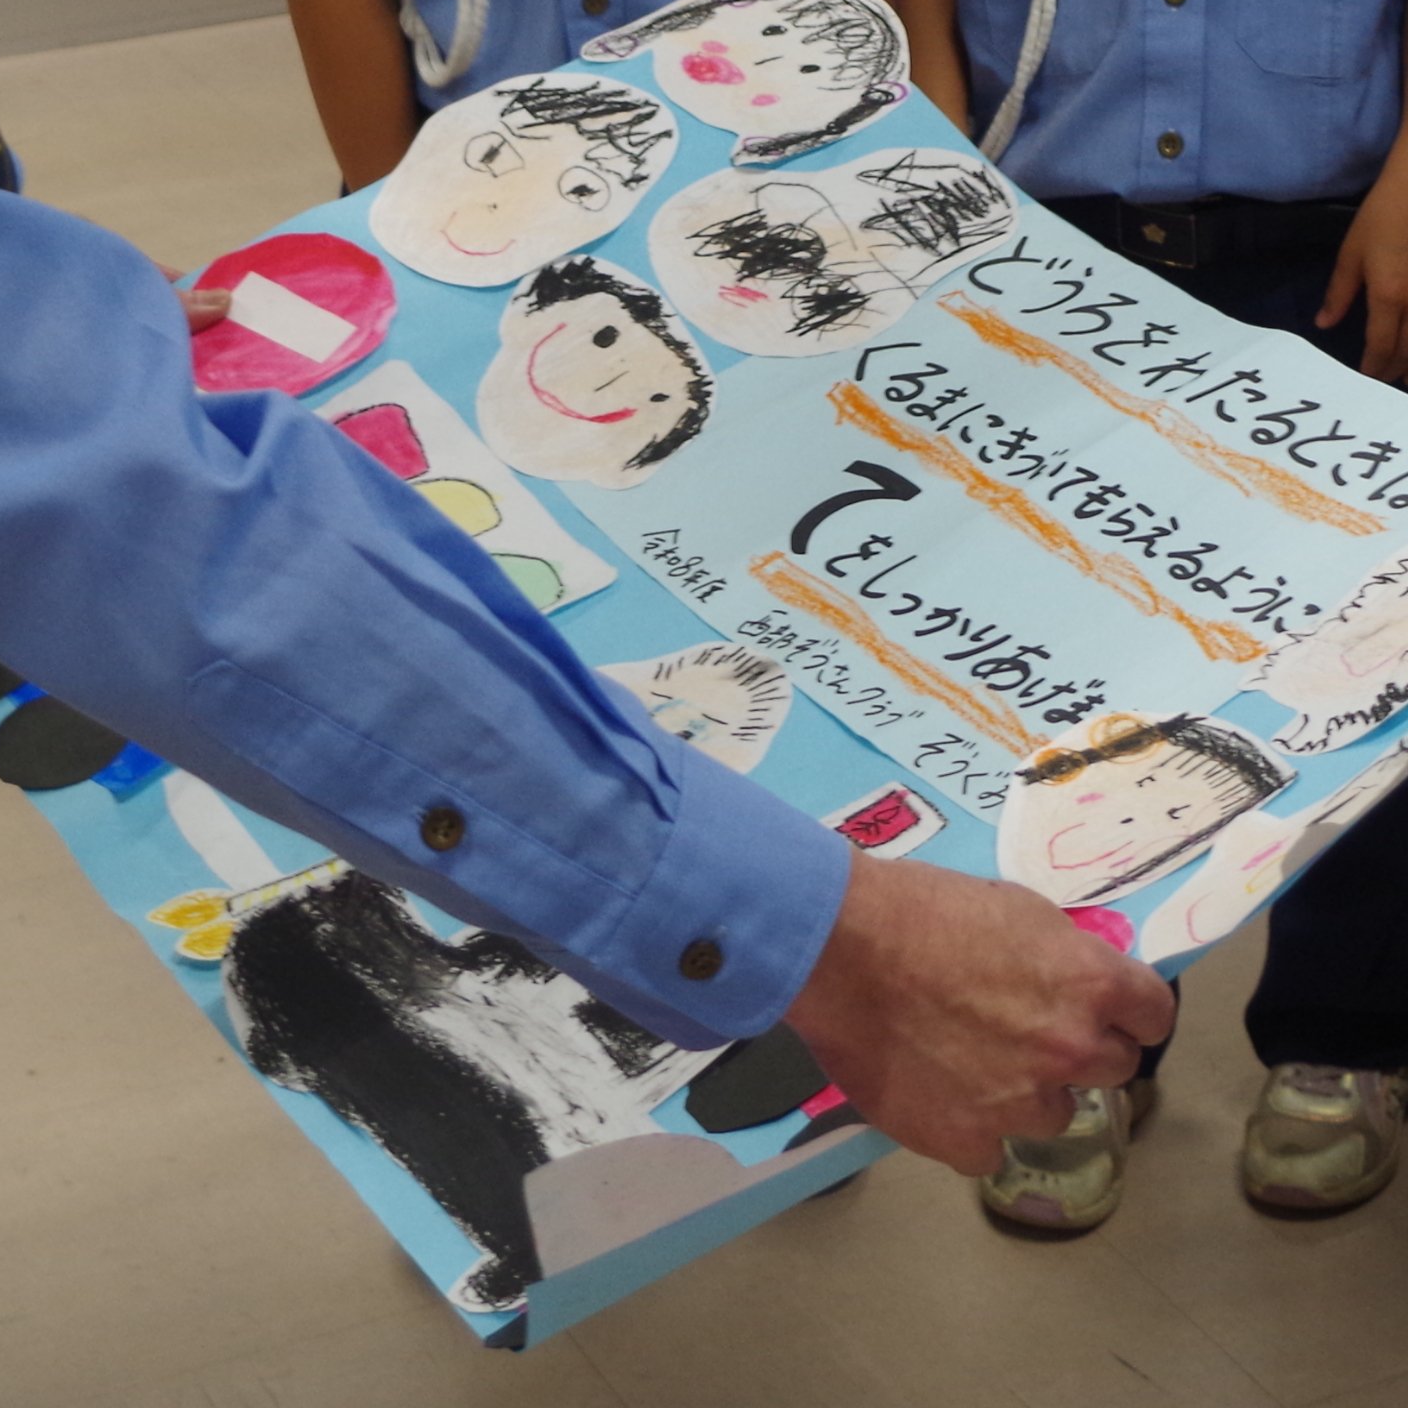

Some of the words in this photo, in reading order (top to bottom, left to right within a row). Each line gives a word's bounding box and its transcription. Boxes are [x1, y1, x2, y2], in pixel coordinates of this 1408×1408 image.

[854, 342, 1322, 634] くるまにきづいてもらえるように
